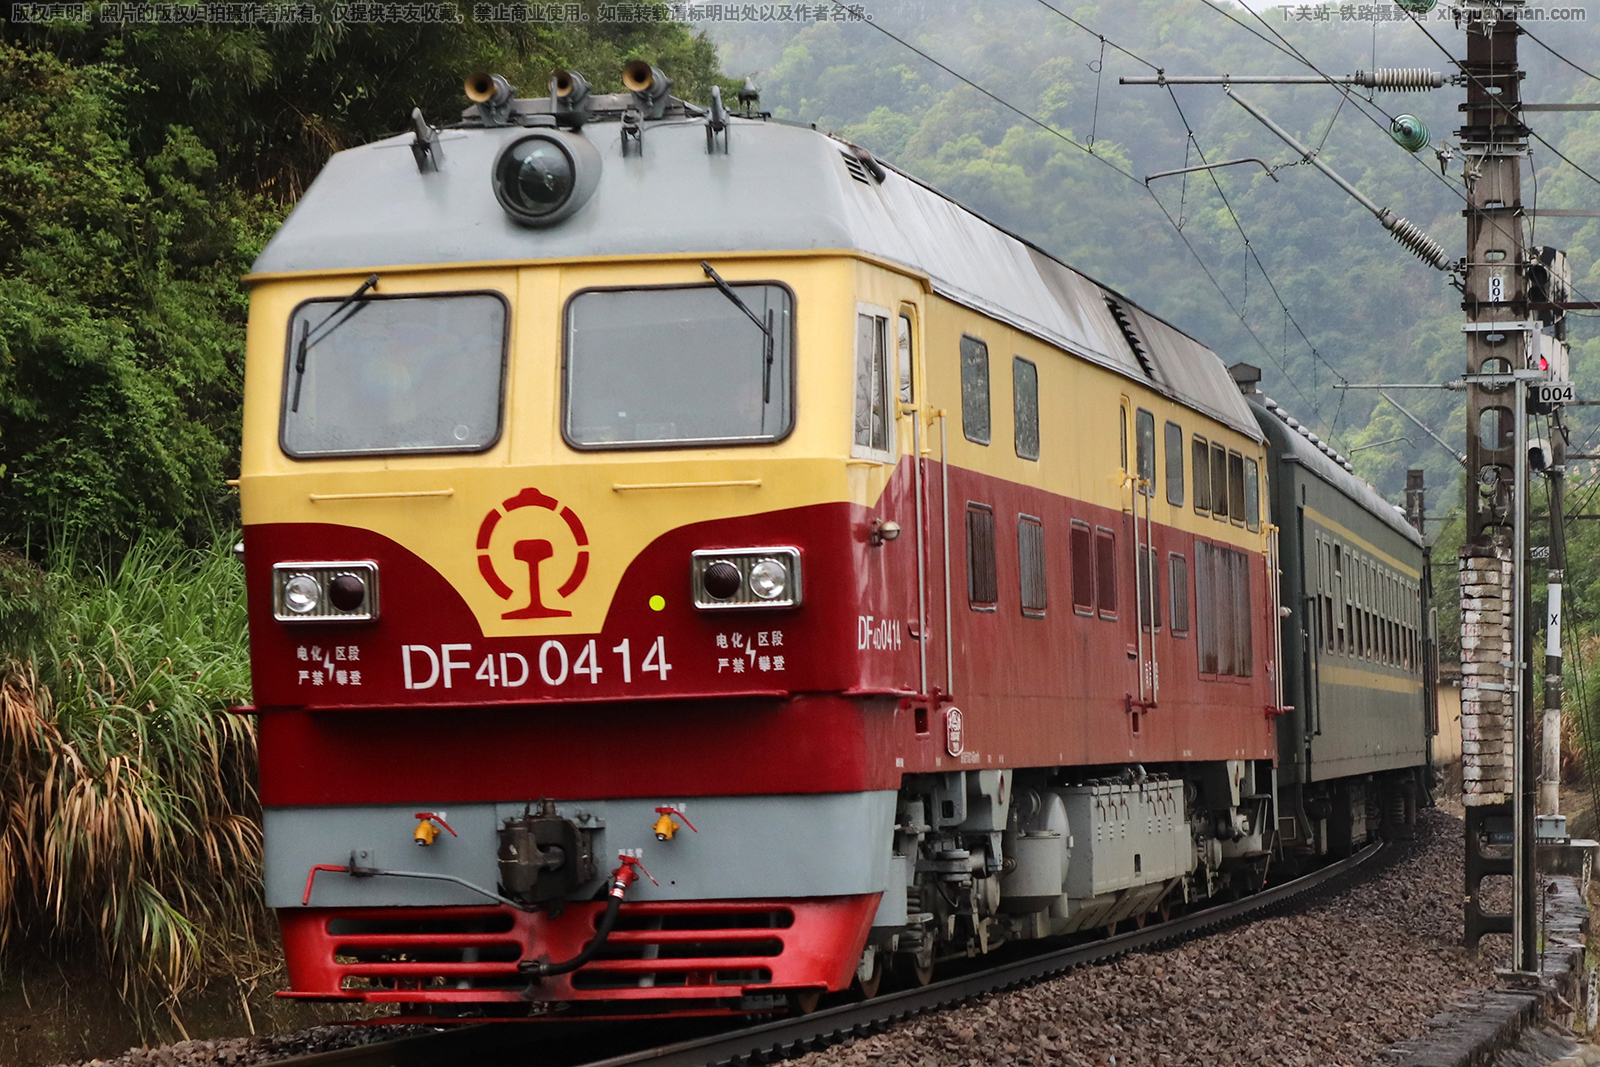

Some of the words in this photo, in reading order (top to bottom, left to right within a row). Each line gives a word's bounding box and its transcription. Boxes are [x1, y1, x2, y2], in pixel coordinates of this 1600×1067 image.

[1541, 387, 1573, 401] 004
[1551, 613, 1558, 625] X
[716, 631, 744, 649] 电化
[757, 630, 784, 647] 区段
[297, 645, 323, 662] 电化
[335, 645, 361, 662] 区段
[717, 657, 746, 674] 严禁
[298, 669, 324, 686] 严禁
